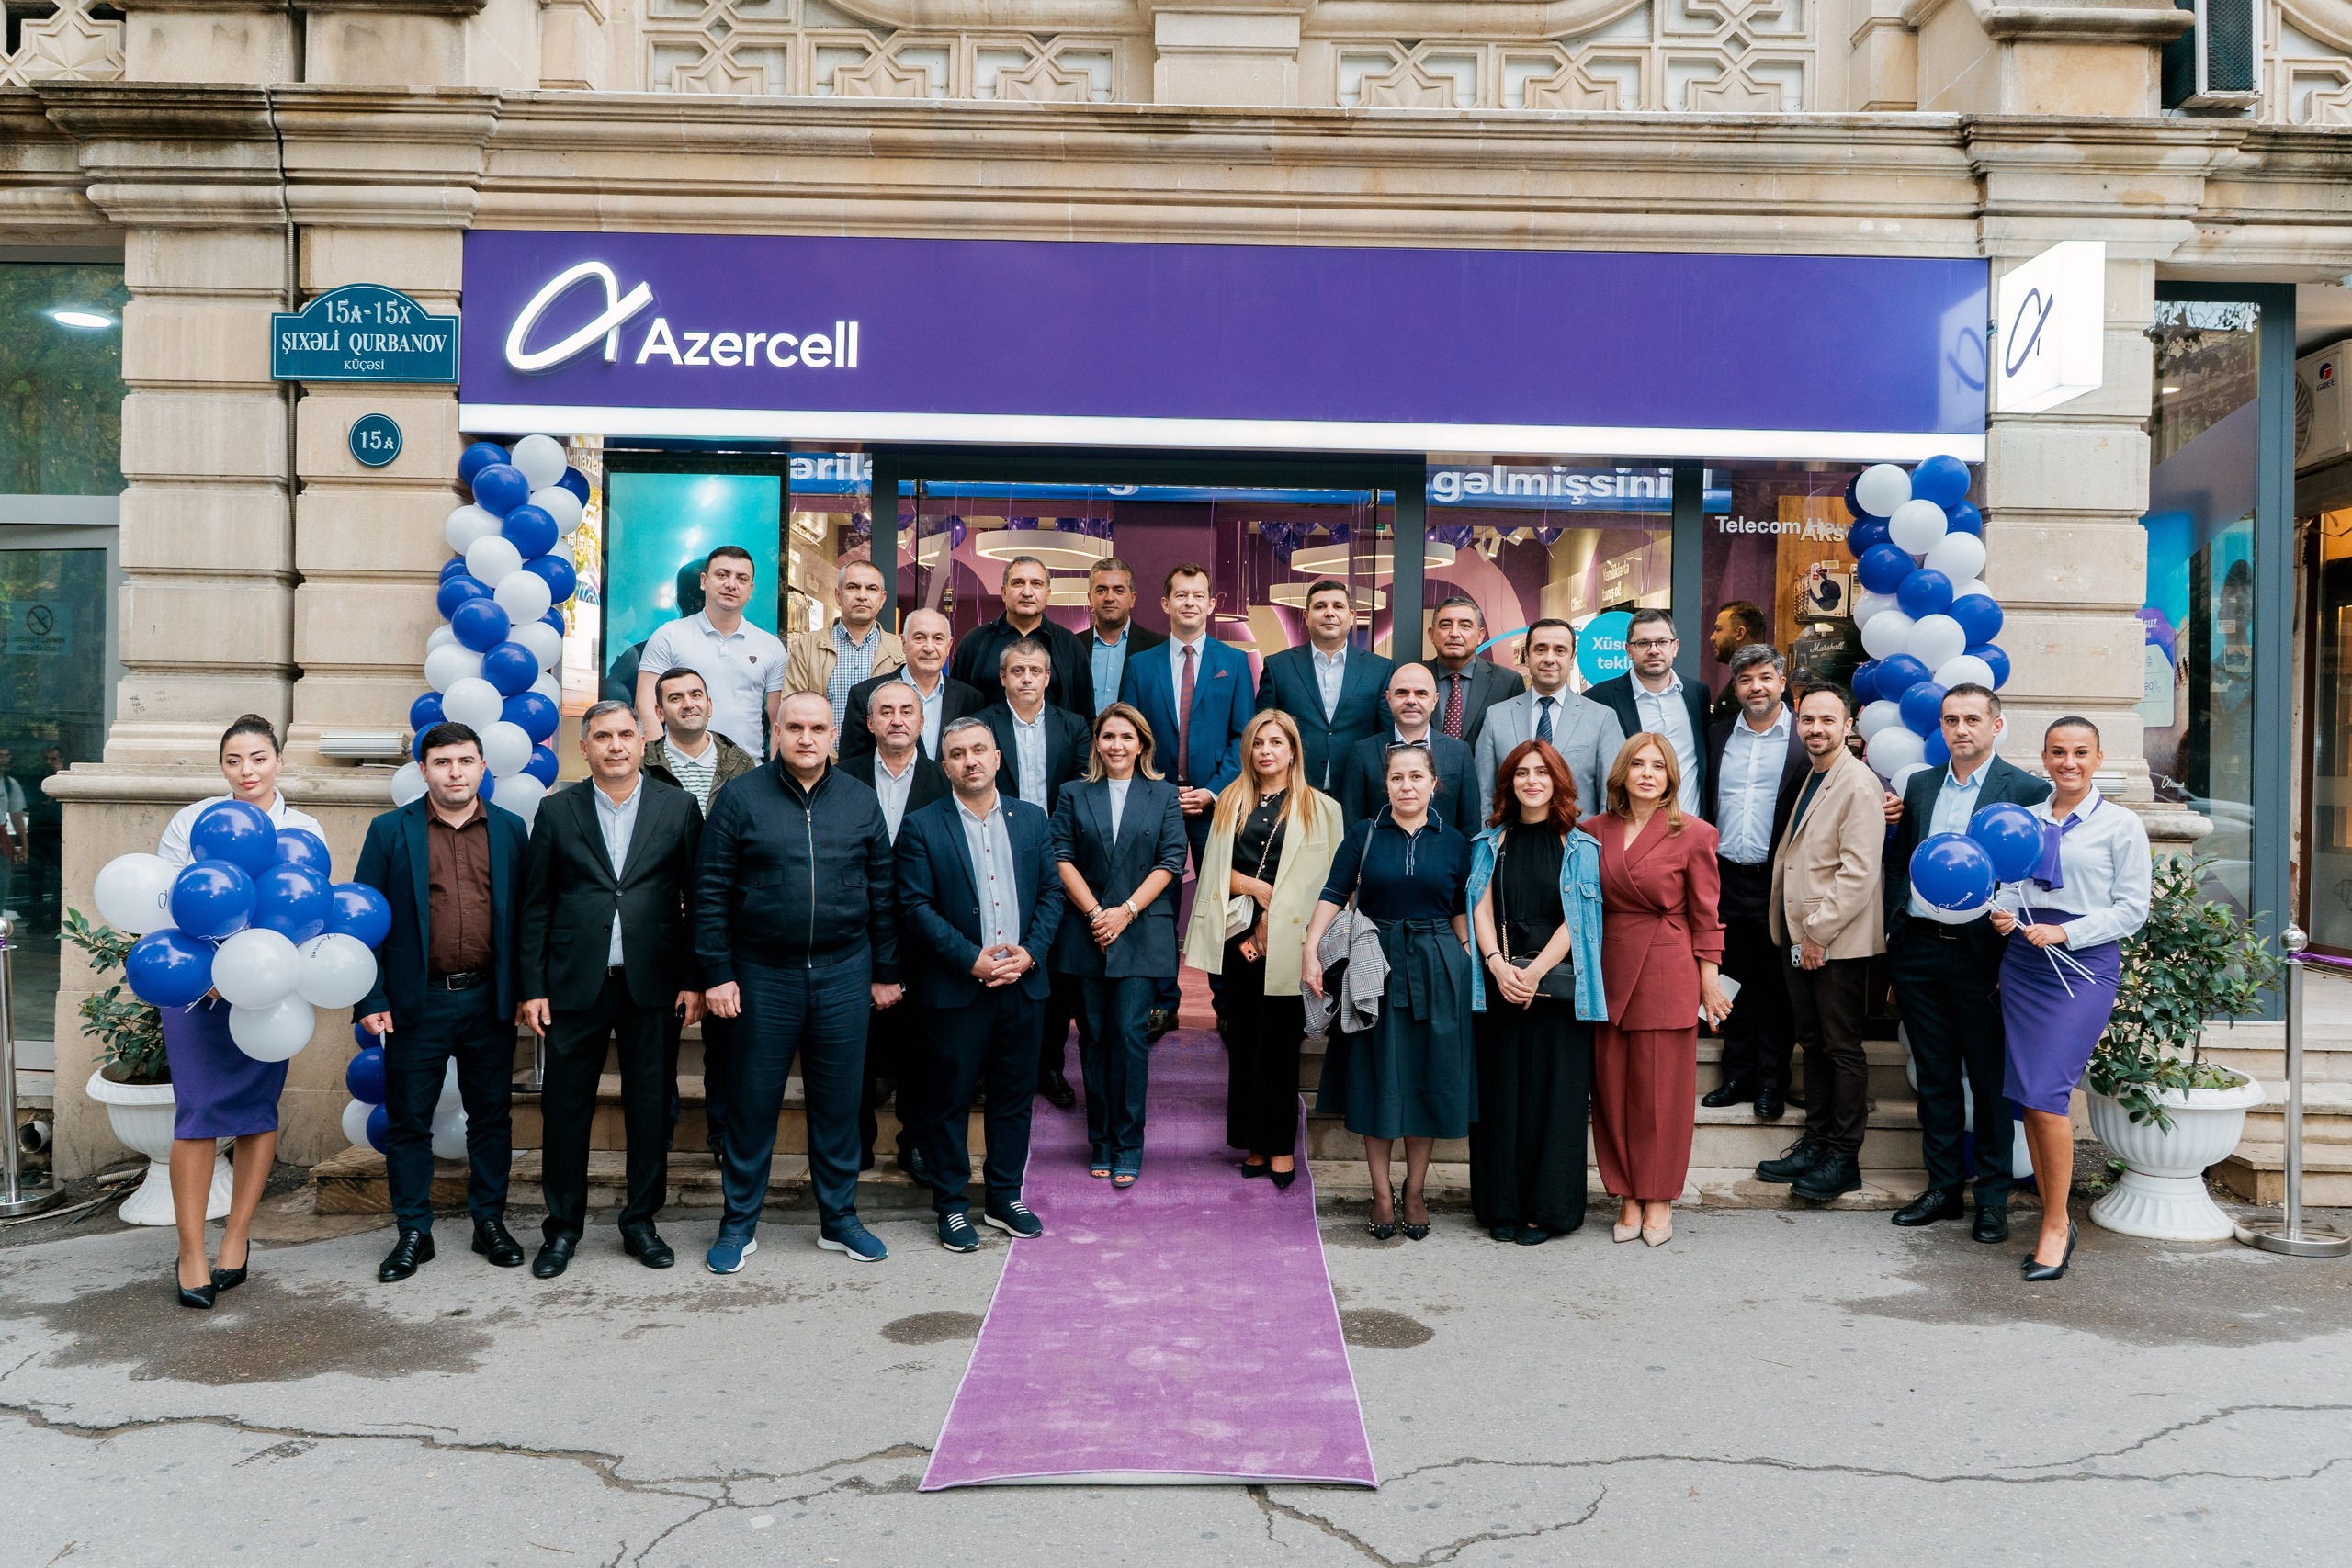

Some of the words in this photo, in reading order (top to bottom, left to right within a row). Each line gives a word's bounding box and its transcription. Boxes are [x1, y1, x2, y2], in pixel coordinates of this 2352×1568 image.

[281, 329, 340, 354] ŞIXƏLİ
[349, 333, 447, 355] QURBANOV
[635, 316, 859, 368] Azercell
[344, 358, 385, 371] KÜÇƏSİ
[2316, 378, 2335, 391] GREE
[1714, 515, 1801, 535] Telecom
[1807, 518, 1849, 535] Hou
[2142, 617, 2158, 628] suz
[1810, 641, 1845, 653] Marshall
